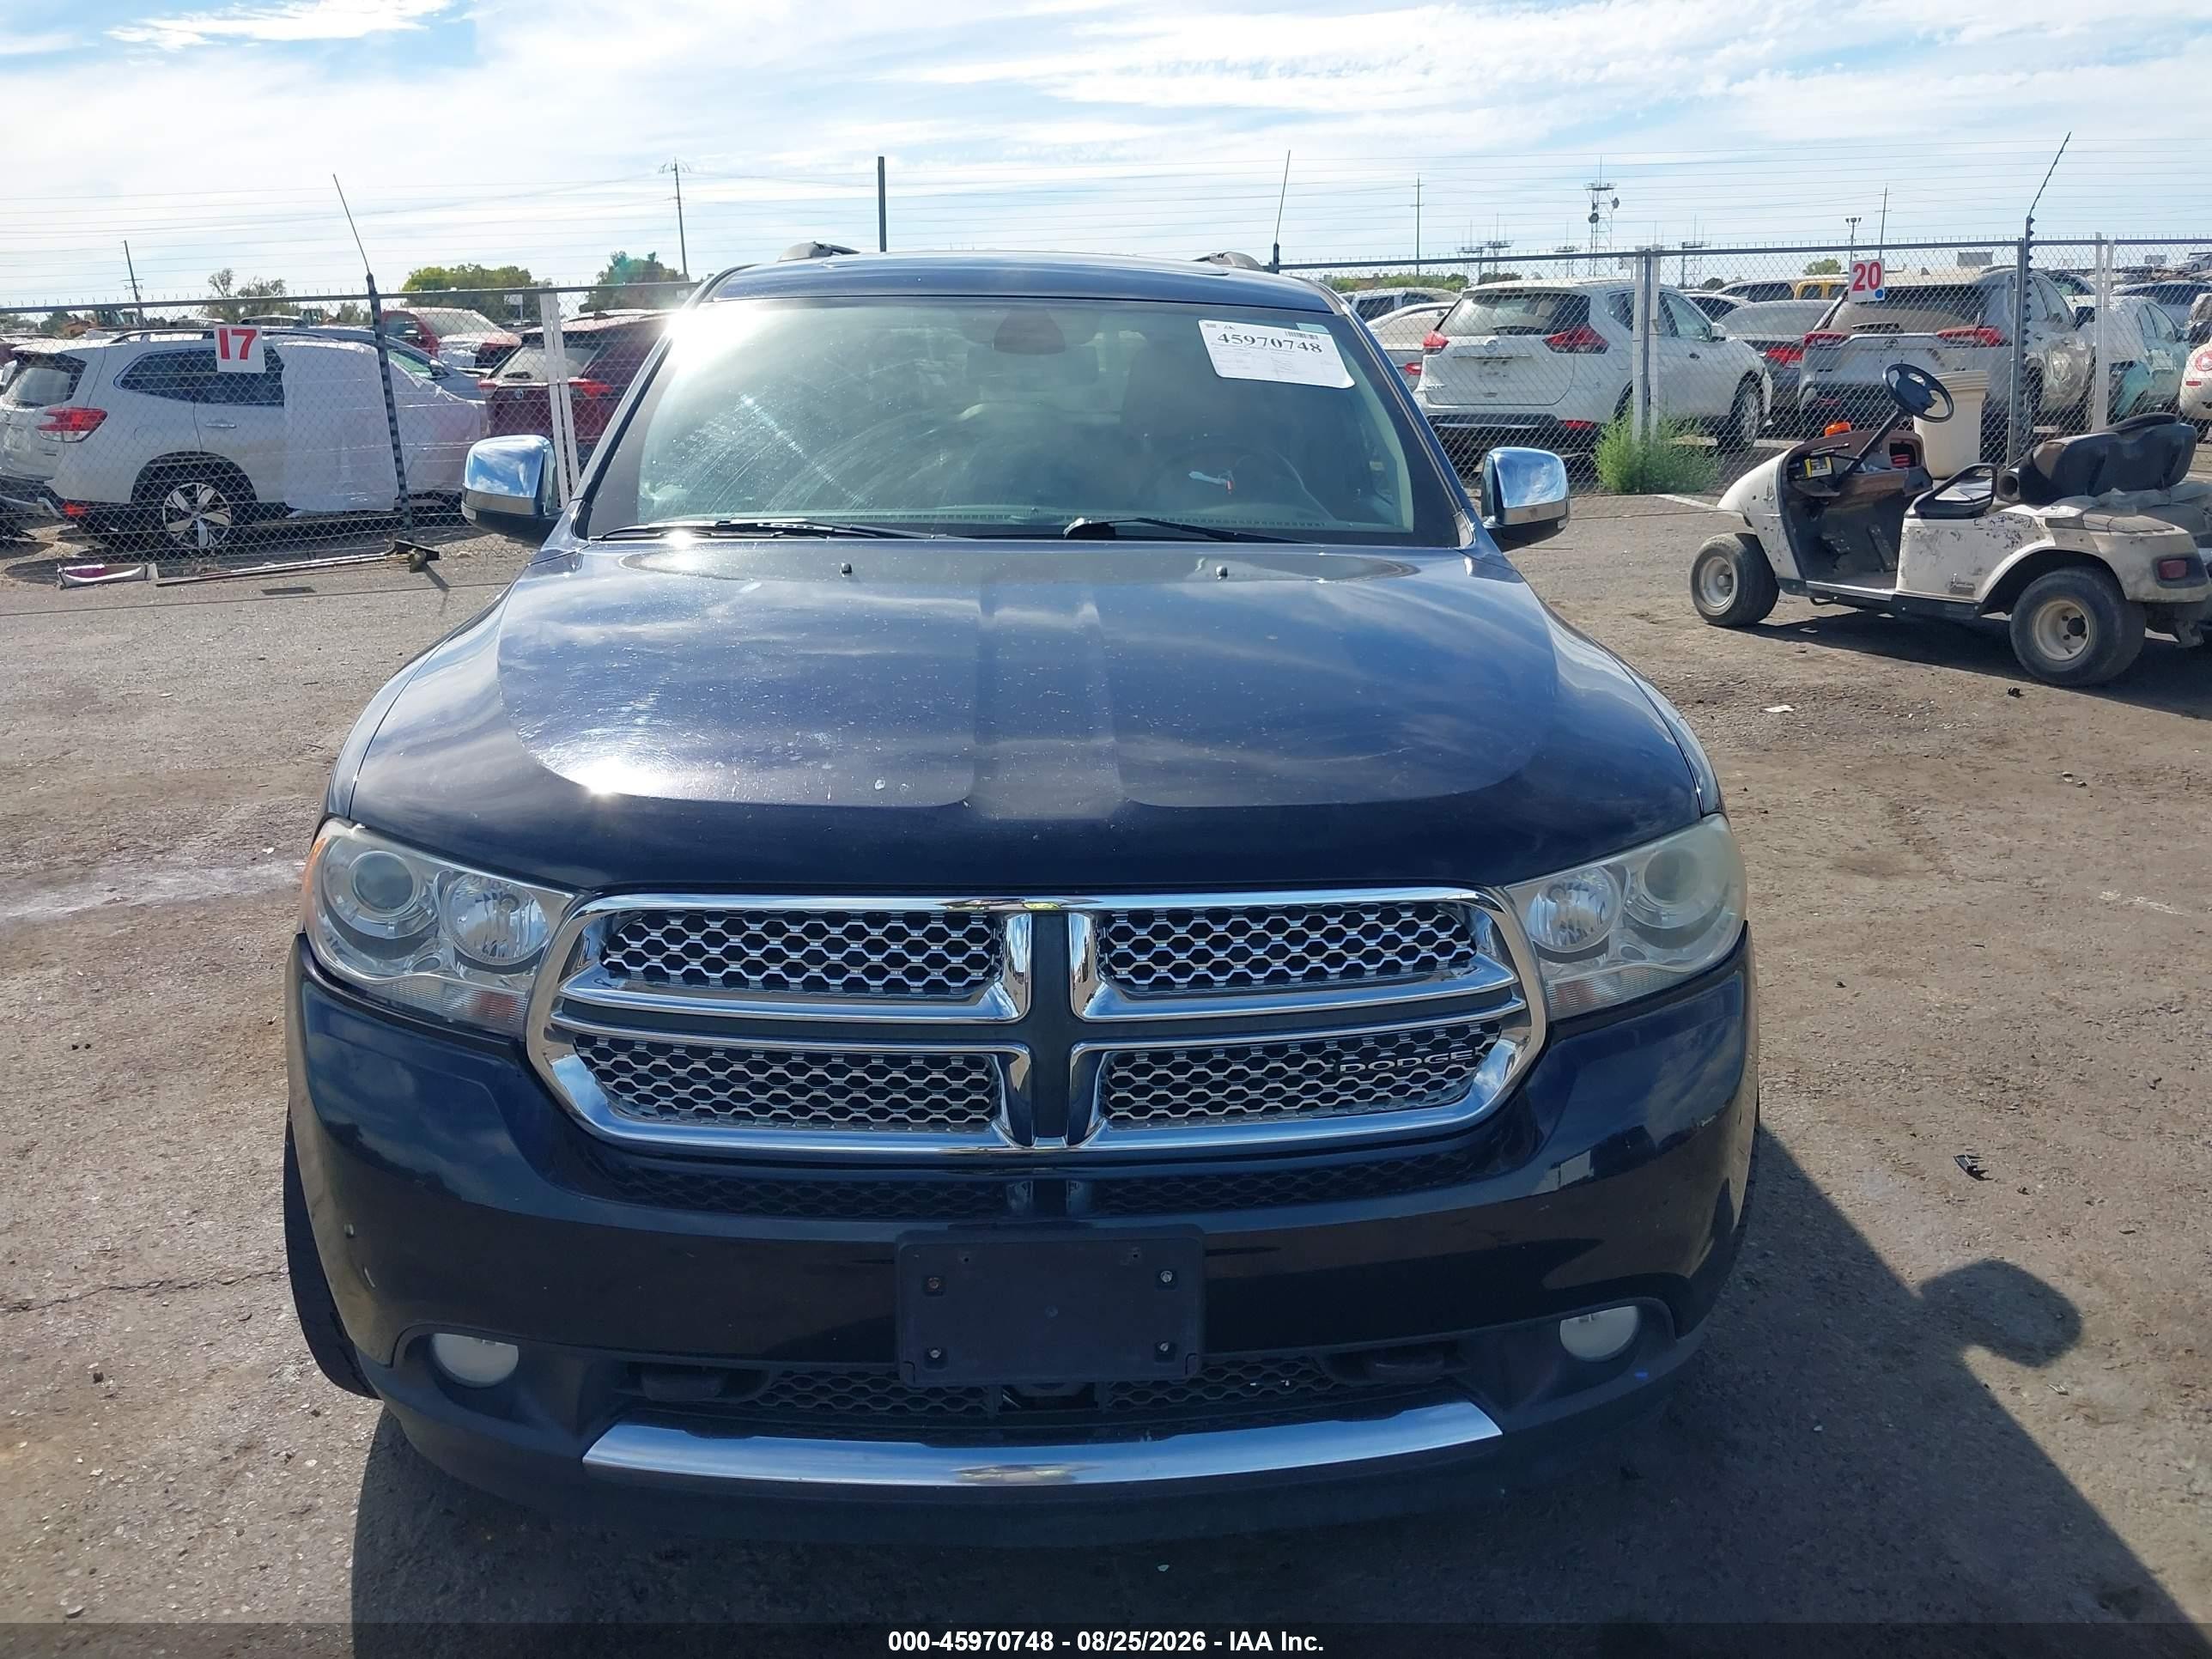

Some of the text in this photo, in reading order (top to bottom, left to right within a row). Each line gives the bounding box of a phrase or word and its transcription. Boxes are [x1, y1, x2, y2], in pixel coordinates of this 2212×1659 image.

[1852, 261, 1881, 292] 20
[219, 328, 257, 360] 17
[1217, 332, 1322, 353] 45970748
[1340, 1049, 1474, 1073] DODGE
